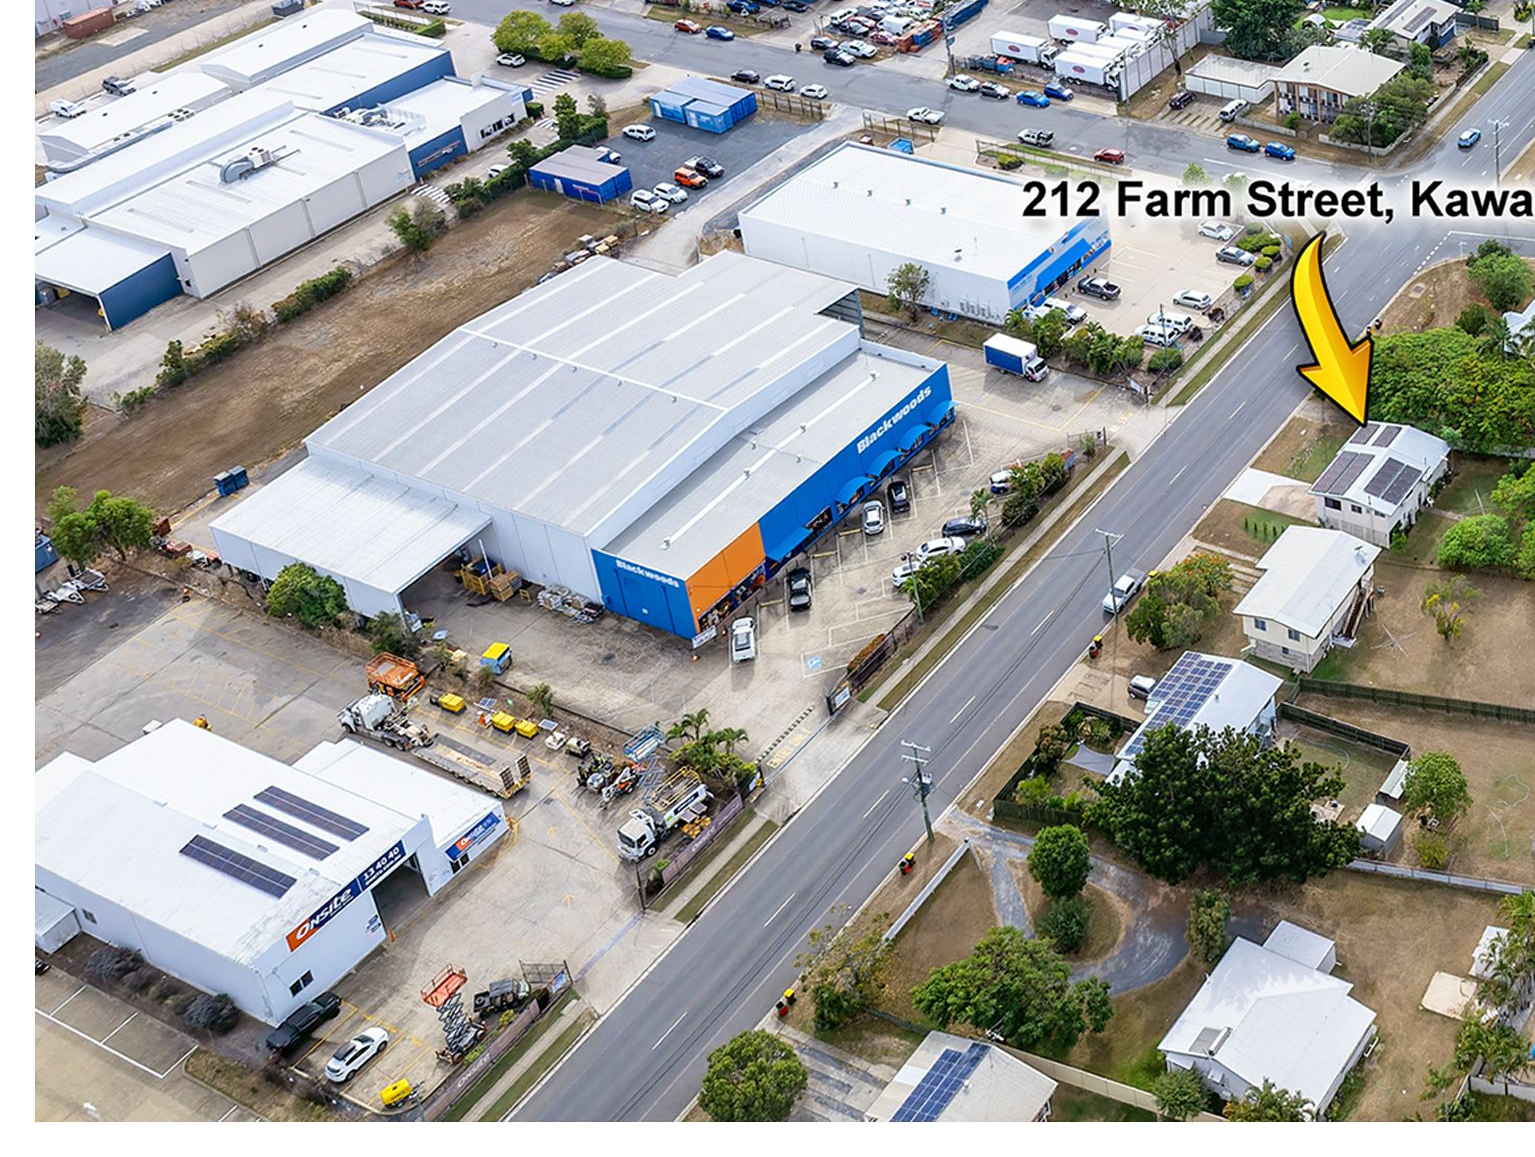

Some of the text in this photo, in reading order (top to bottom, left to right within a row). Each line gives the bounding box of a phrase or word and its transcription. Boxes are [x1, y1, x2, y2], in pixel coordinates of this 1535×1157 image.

[856, 386, 932, 454] Blackwoods
[616, 560, 680, 588] Blackwoods
[364, 867, 374, 881] 13
[376, 857, 387, 870] 40
[388, 846, 399, 859] 40
